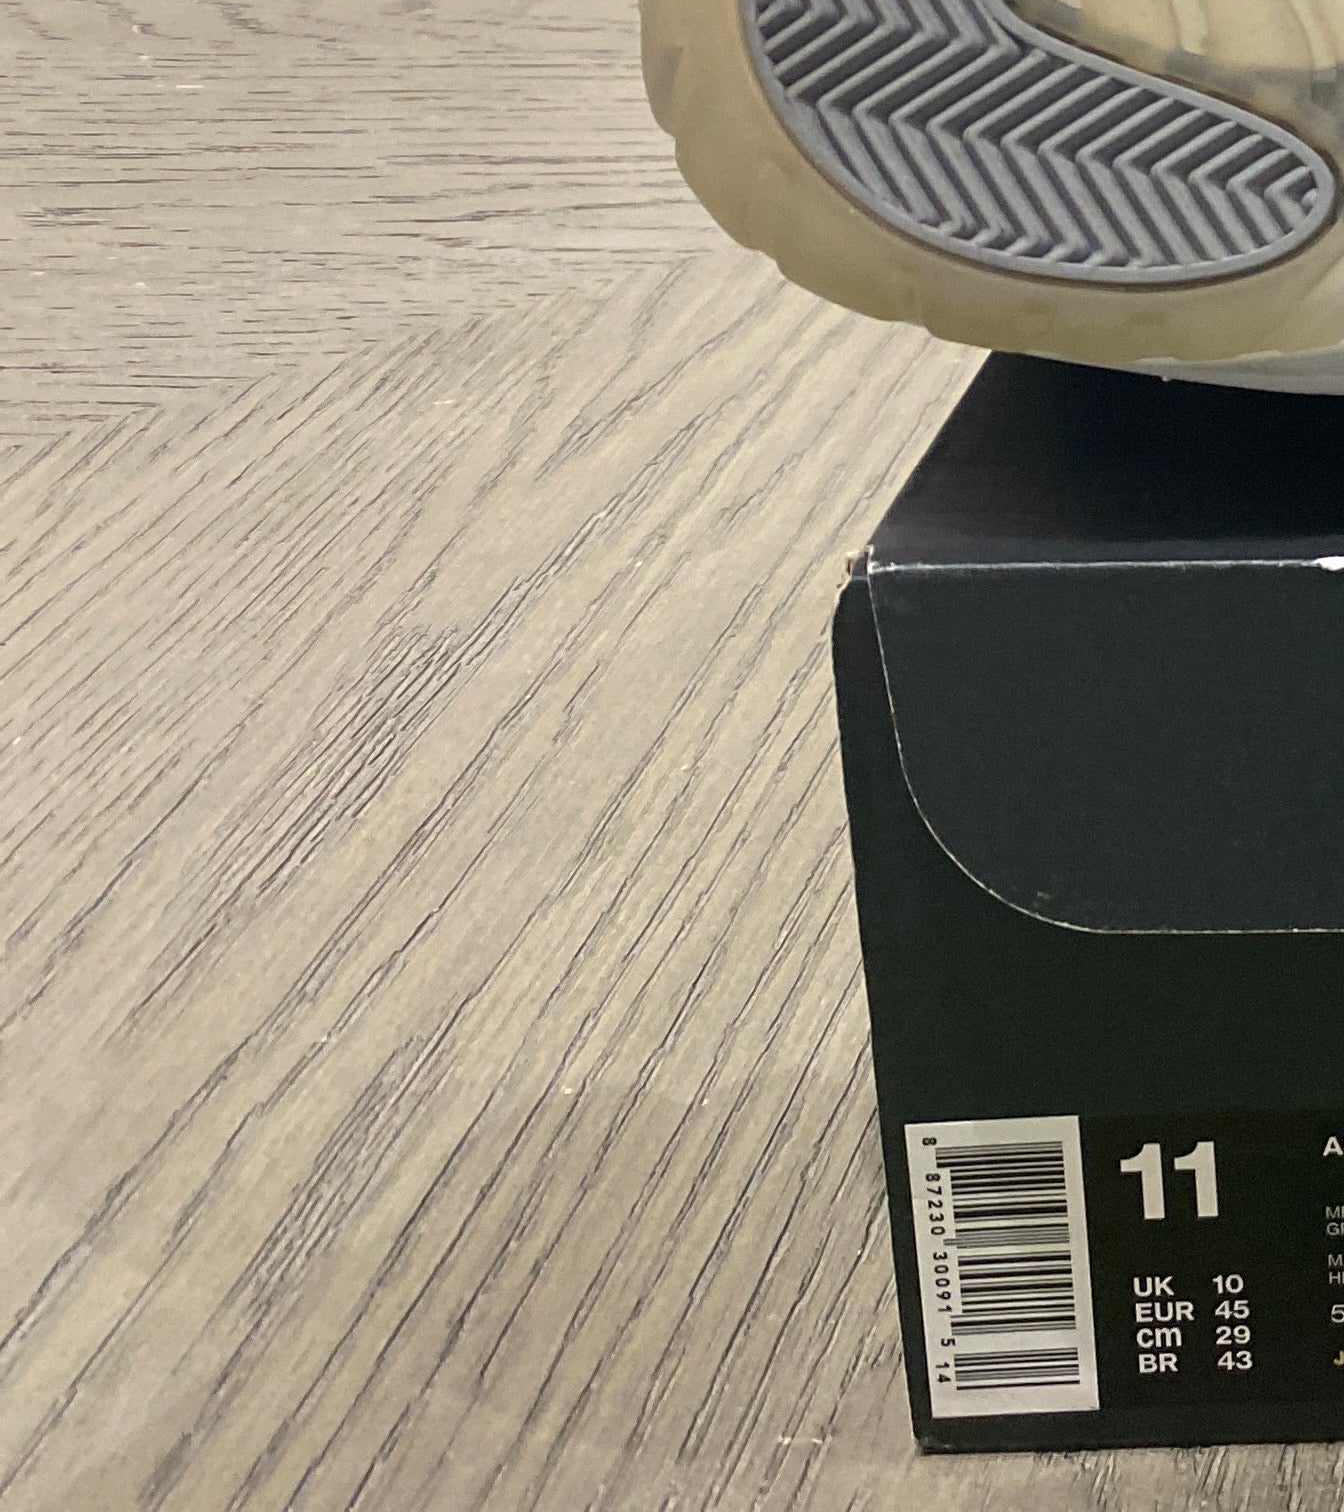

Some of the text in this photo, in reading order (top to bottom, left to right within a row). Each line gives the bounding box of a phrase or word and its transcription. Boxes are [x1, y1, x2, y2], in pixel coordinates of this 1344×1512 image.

[1120, 1141, 1219, 1220] 11
[922, 1137, 956, 1347] 8 87230 30091 5
[1133, 1274, 1244, 1297] UK 10
[1135, 1300, 1250, 1322] EUR 45
[1137, 1325, 1250, 1348] cm 29
[936, 1362, 951, 1383] 14
[1139, 1351, 1252, 1373] BR 43
